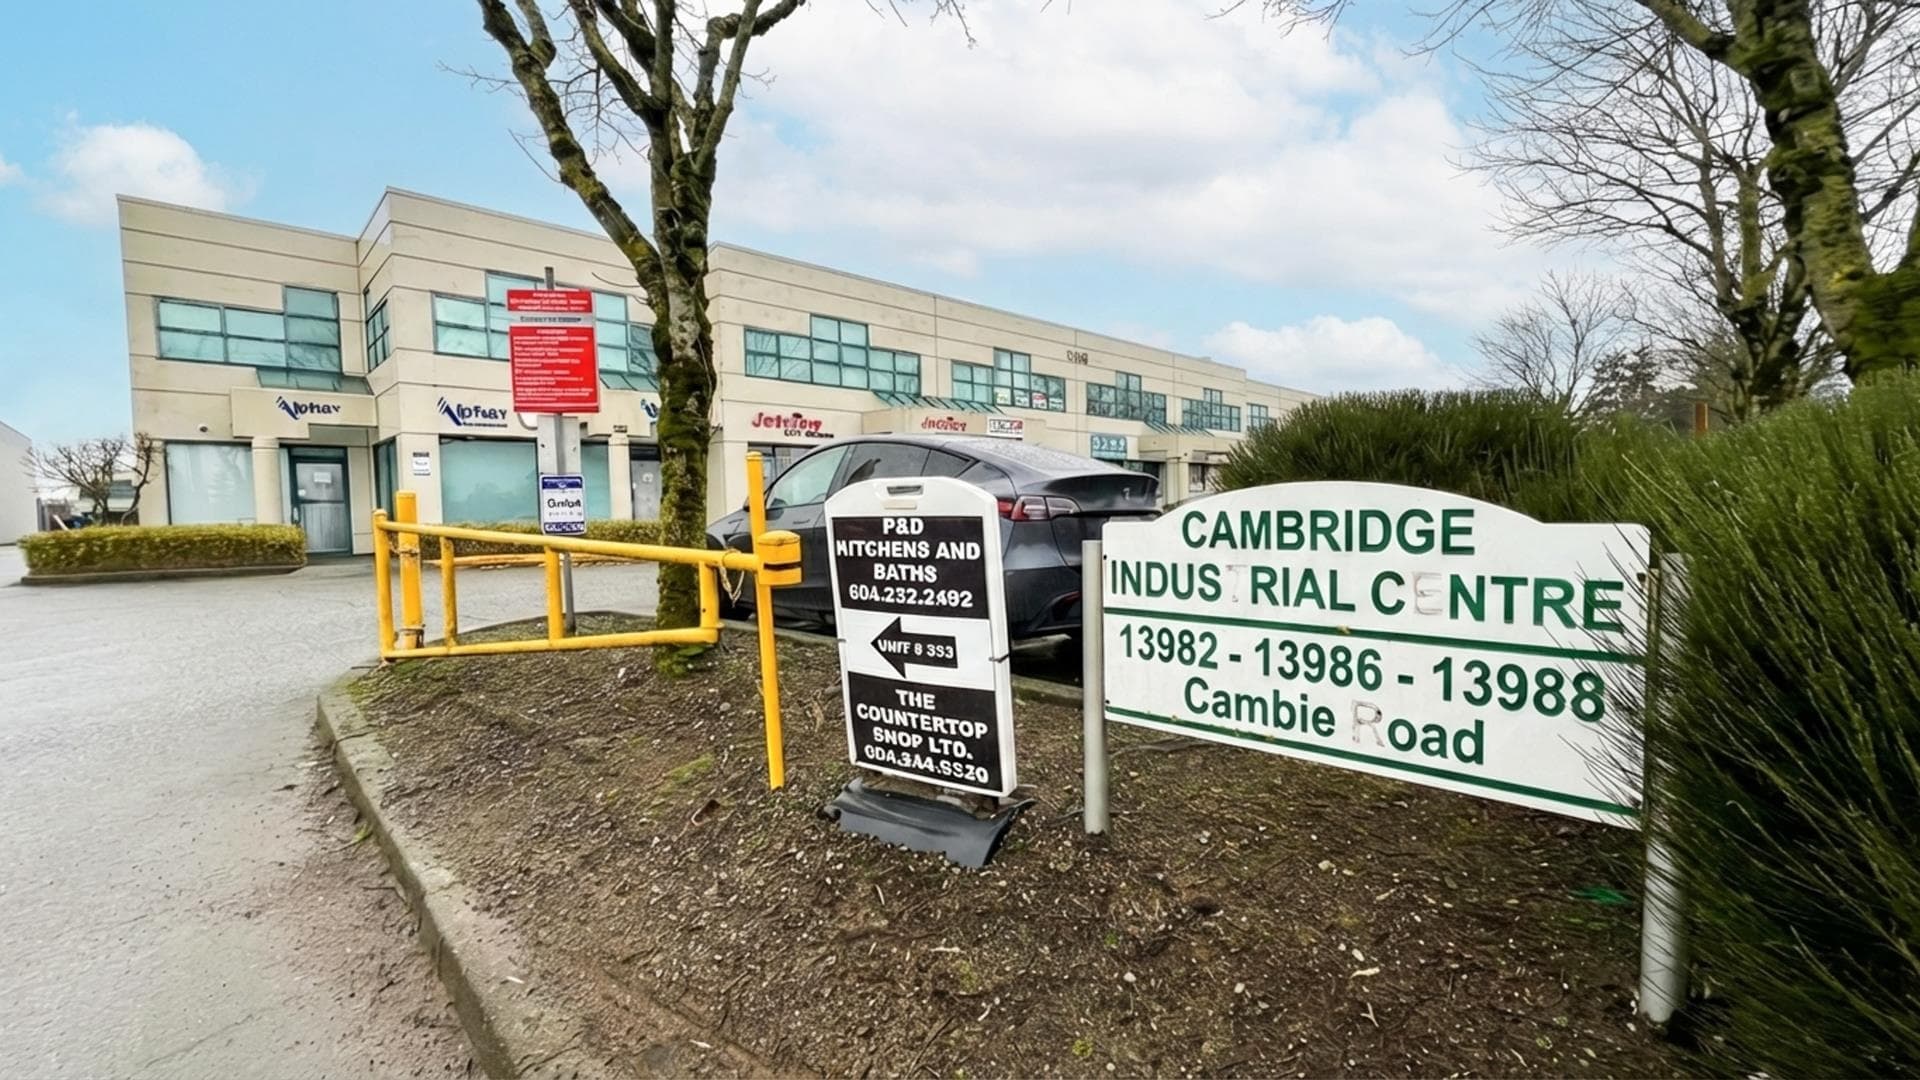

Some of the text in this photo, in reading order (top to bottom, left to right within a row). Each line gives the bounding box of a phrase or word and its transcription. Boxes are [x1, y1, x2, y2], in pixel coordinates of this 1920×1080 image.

[883, 517, 924, 535] P&D
[1182, 509, 1475, 555] CAMBRIDGE
[935, 542, 981, 560] AND
[873, 563, 937, 583] BATHS
[1119, 623, 1218, 669] 13982
[1254, 637, 1382, 691] 13986
[1433, 656, 1606, 722] 13988
[895, 689, 936, 710] THE
[1184, 677, 1336, 737] Cambie
[856, 703, 988, 739] COUNTERTOP
